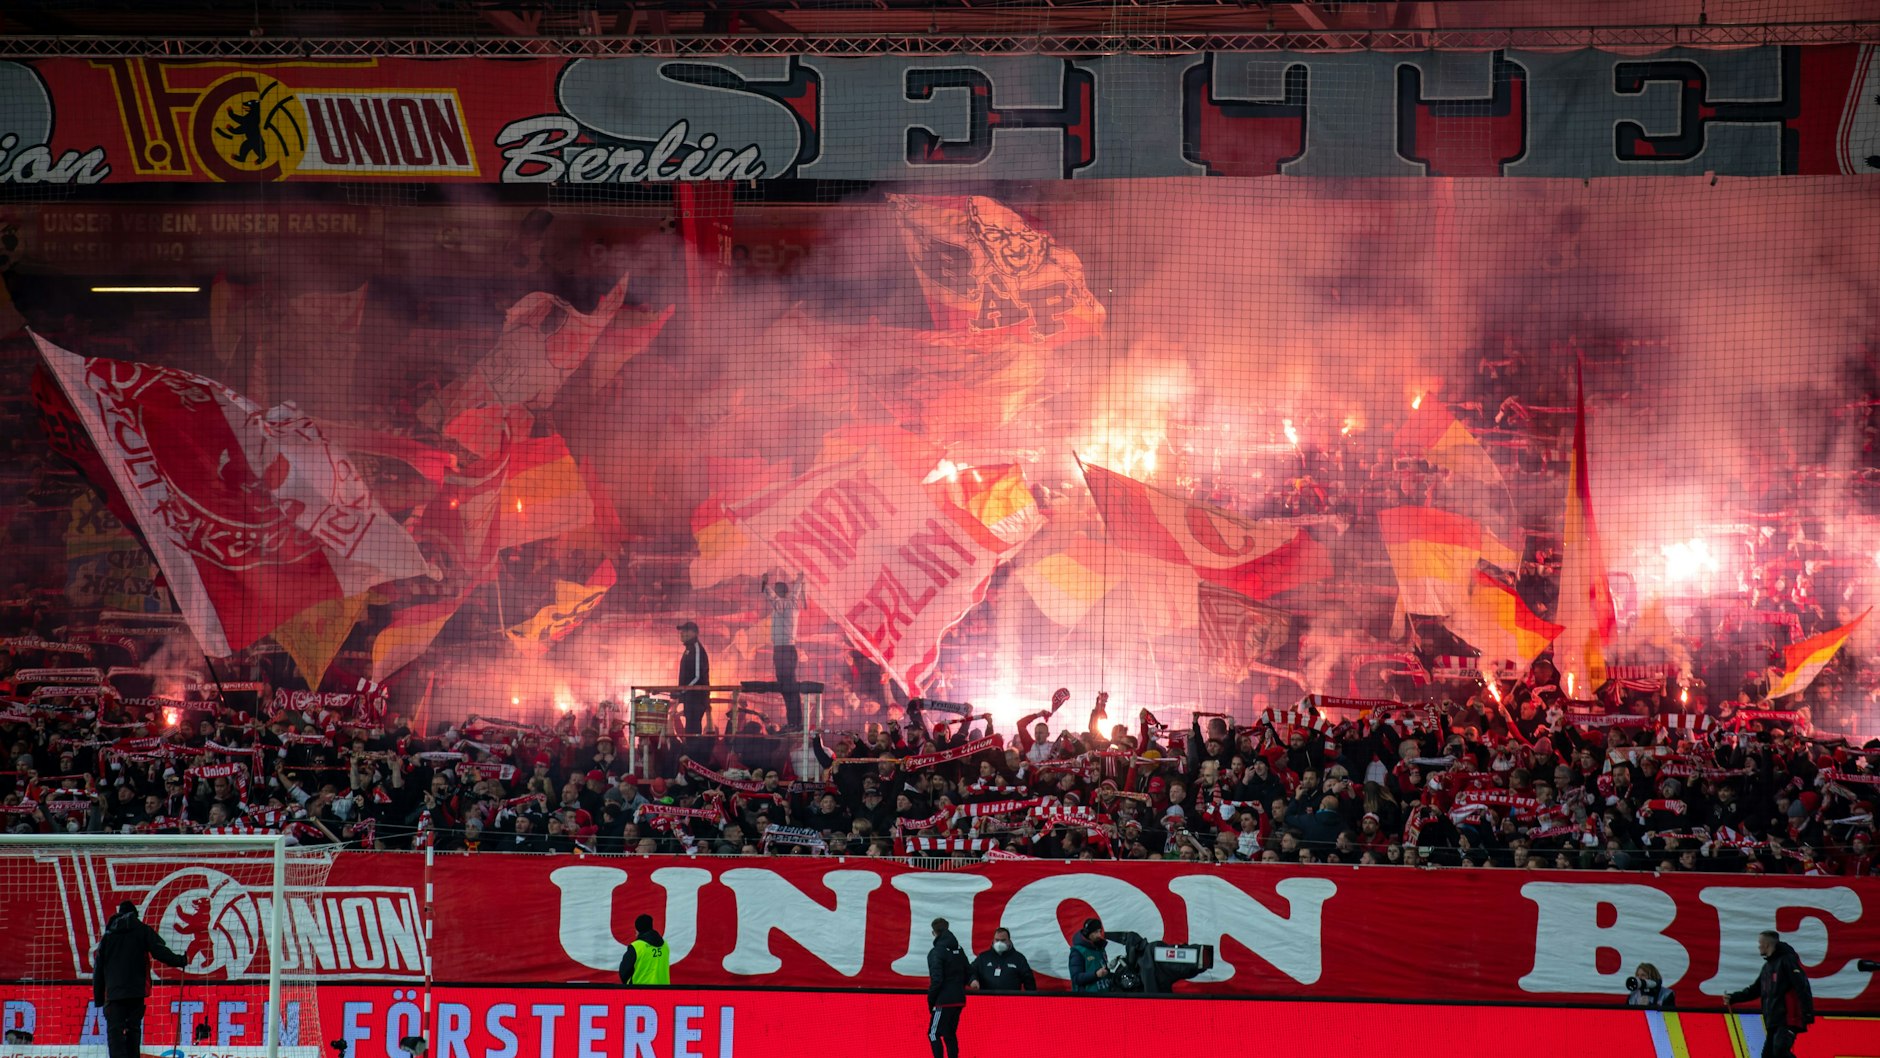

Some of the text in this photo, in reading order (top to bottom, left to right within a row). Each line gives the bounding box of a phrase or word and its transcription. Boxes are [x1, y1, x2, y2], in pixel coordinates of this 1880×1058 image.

[306, 96, 470, 166] UNION
[496, 115, 767, 184] Berlin
[43, 213, 363, 236] UNSER VEREIN, UNSER RASEN,
[770, 469, 897, 591] NION
[845, 517, 977, 658] ERLIN
[202, 764, 231, 778] Union
[961, 737, 993, 754] Union
[666, 806, 690, 814] Union
[982, 801, 1022, 813] UNION
[257, 893, 423, 972] UNION
[549, 865, 1873, 1000] UNION BE
[651, 947, 662, 958] 25
[80, 1000, 300, 1046] ATEN
[342, 990, 735, 1058] FÖRSTEREI
